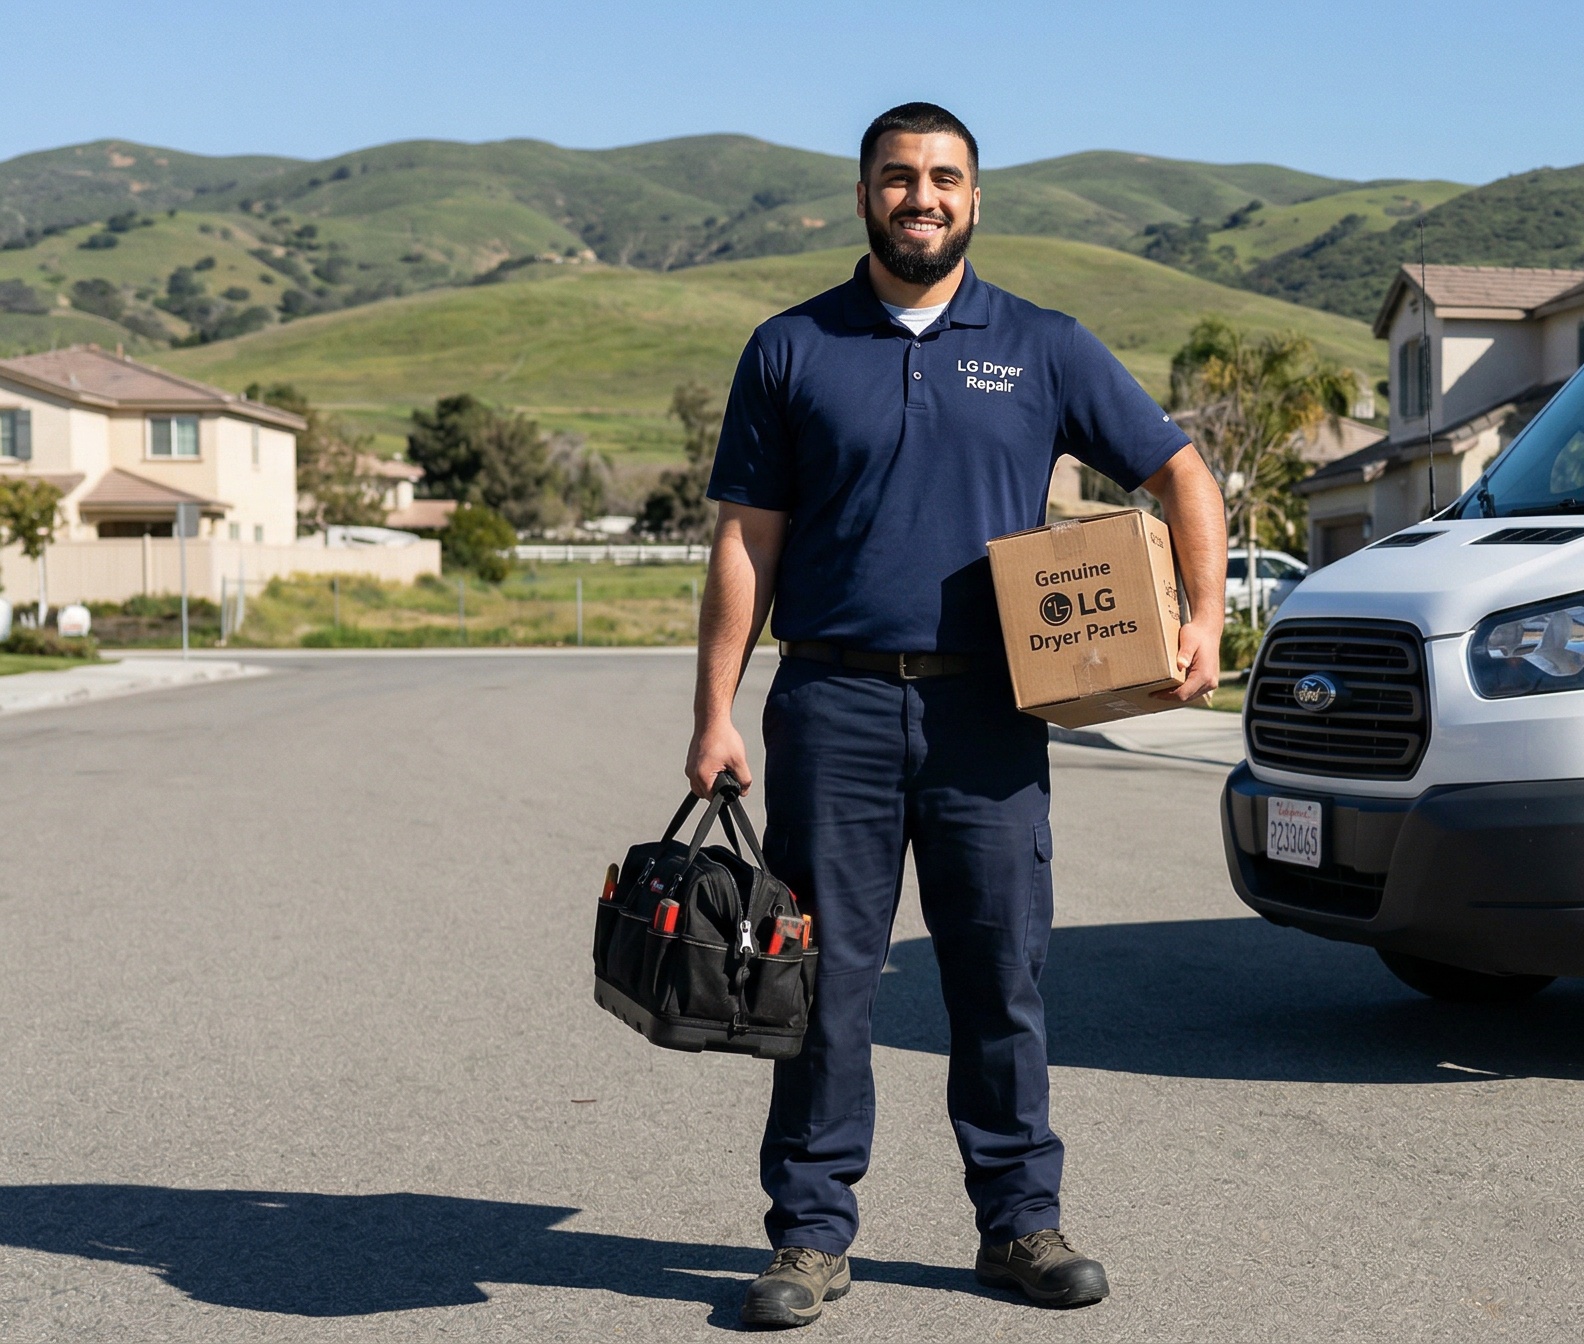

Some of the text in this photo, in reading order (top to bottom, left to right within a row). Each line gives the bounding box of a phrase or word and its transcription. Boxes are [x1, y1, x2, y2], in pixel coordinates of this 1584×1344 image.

[957, 359, 1024, 378] LG Dryer
[966, 376, 1015, 393] Repair
[1035, 562, 1111, 587] Genuine
[1078, 588, 1116, 616] LG
[1029, 620, 1138, 652] Dryer Parts
